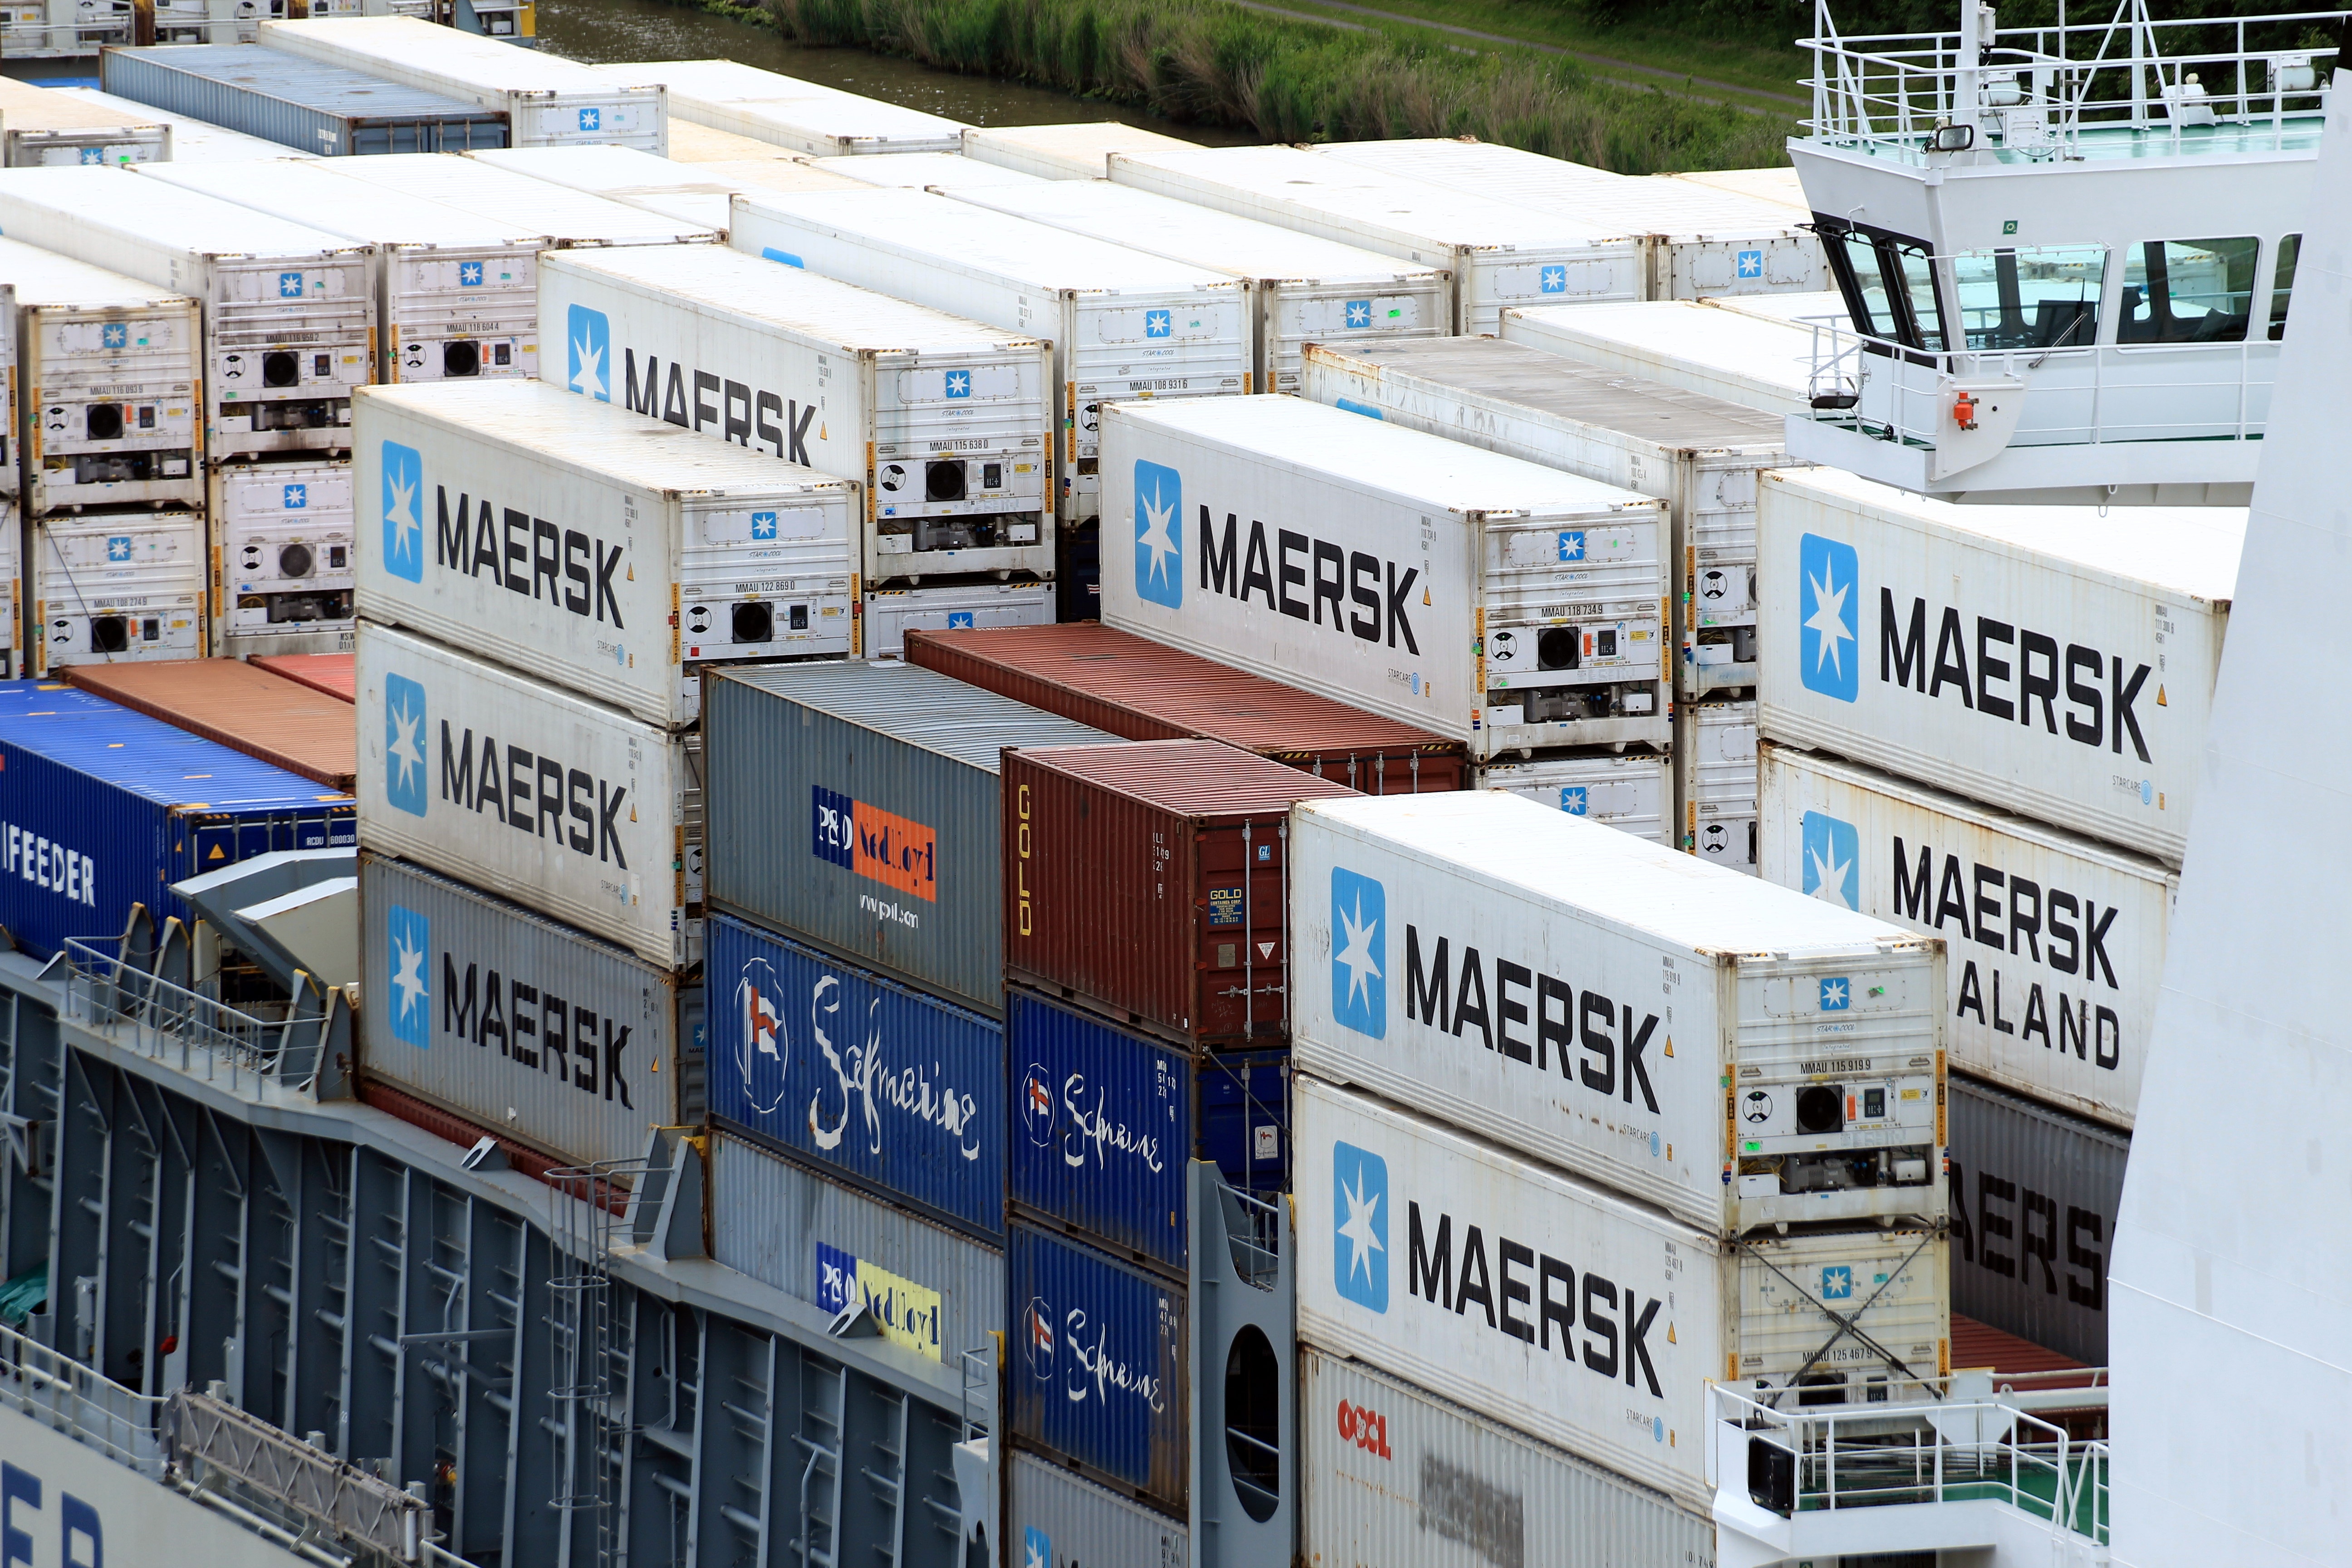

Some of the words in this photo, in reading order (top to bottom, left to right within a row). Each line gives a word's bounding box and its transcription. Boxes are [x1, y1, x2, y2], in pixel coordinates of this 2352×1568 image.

[447, 323, 466, 333] MMAU
[495, 322, 499, 330] 4
[267, 335, 286, 343] MMAU
[315, 333, 319, 341] 2
[91, 386, 110, 395] MMAU
[1130, 381, 1152, 391] MMAU
[1155, 380, 1166, 390] 108
[1169, 380, 1181, 389] 931
[1184, 379, 1187, 389] 6
[930, 441, 952, 451] MMAU
[955, 441, 967, 450] 115
[970, 440, 982, 449] 638
[984, 439, 988, 448] 0
[437, 484, 624, 629] MAERSK
[736, 583, 758, 593] MMAU
[761, 582, 774, 591] 122
[776, 581, 789, 590] 869
[791, 580, 794, 589] 0
[1200, 504, 1420, 657] MAERSK
[94, 599, 115, 608] MMAU
[1542, 607, 1565, 617] MMAU
[1568, 606, 1581, 616] 118
[1583, 604, 1596, 614] 734
[1598, 604, 1602, 613] 9
[598, 640, 617, 655] STARCARE
[1388, 667, 1411, 684] STARCARE
[1881, 586, 2152, 763] MAERSK
[2112, 774, 2141, 793] STARCARE
[441, 719, 628, 871] MAERSK
[307, 836, 324, 846] RCDU
[330, 834, 355, 844] 600030
[1019, 784, 1031, 936] GOLD
[1259, 846, 1269, 856] GL
[1210, 889, 1241, 900] GOLD
[1894, 836, 2119, 990] MAERSK
[1406, 923, 1661, 1115] MAERSK
[1957, 959, 2119, 1071] ALAND
[444, 951, 634, 1110] MAERSK
[1801, 1063, 1827, 1074] MMAU
[1832, 1061, 1846, 1072] 115
[1848, 1060, 1863, 1071] 919
[1866, 1059, 1870, 1070] 9
[1623, 1124, 1650, 1144] STARCARE
[1949, 1159, 2116, 1311] AERS
[1409, 1199, 1663, 1399] MAERSK
[1834, 1349, 1847, 1361] 125
[1850, 1348, 1864, 1360] 467
[1867, 1348, 1872, 1358] 9
[1626, 1408, 1653, 1429] STARCARE
[1338, 1398, 1391, 1461] OOCL
